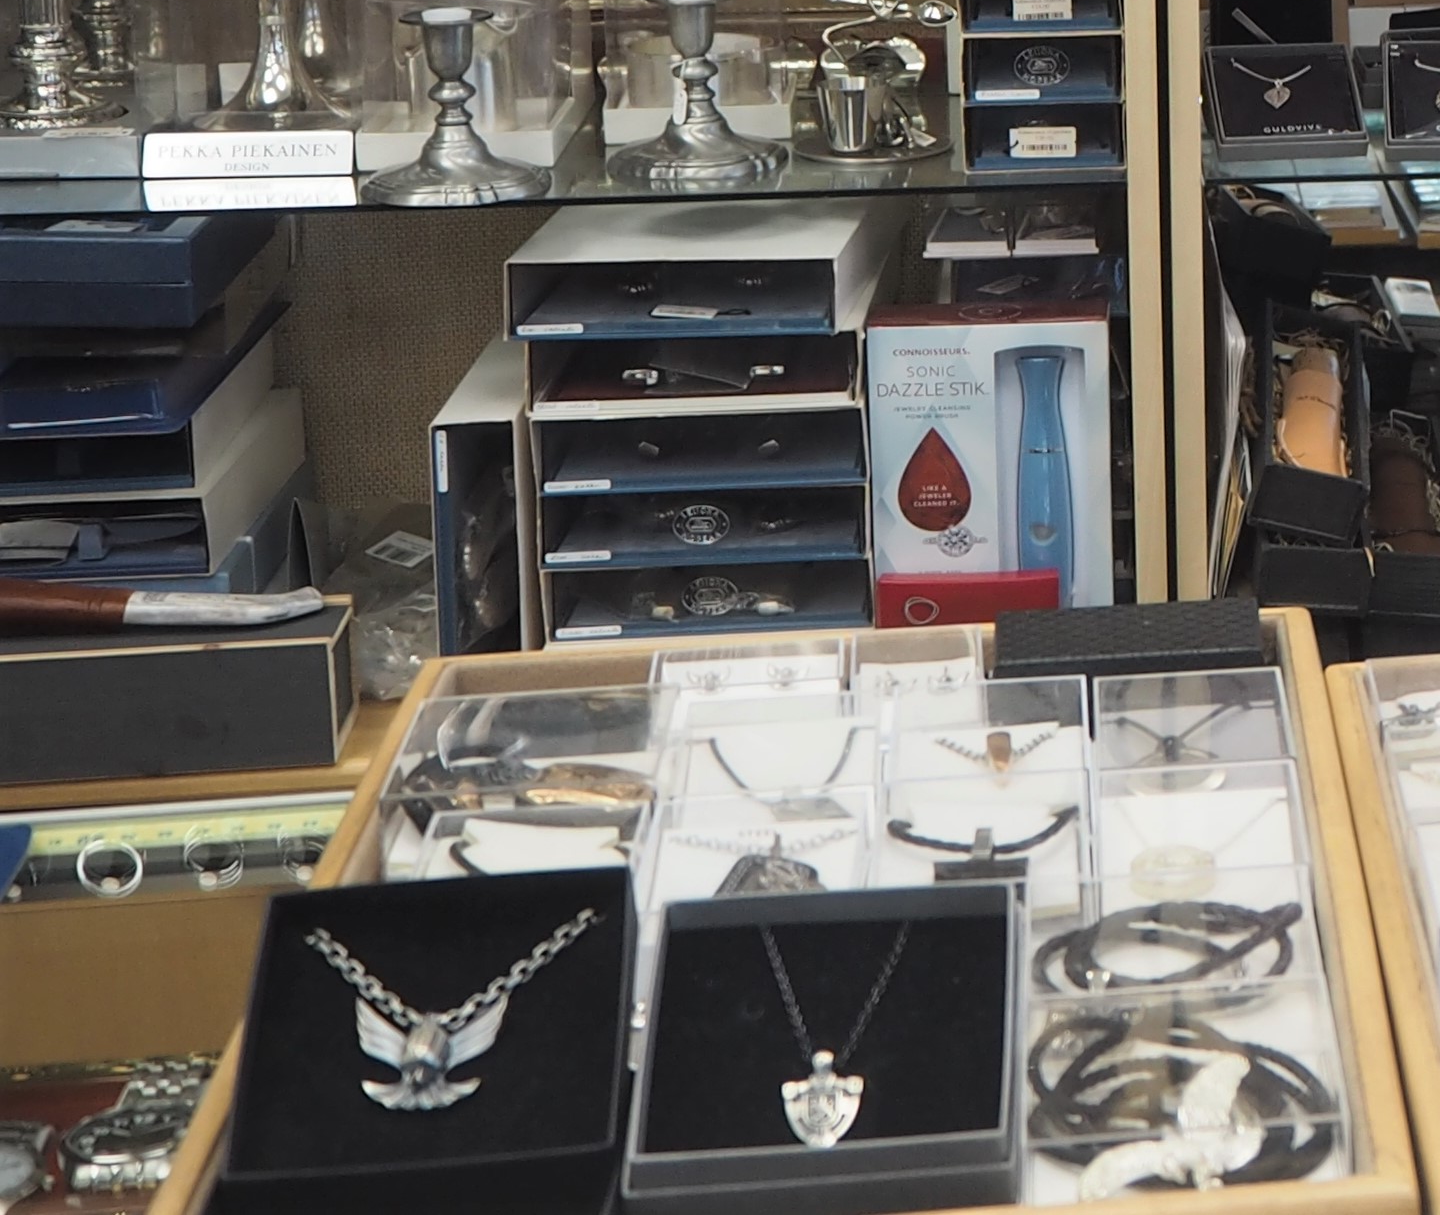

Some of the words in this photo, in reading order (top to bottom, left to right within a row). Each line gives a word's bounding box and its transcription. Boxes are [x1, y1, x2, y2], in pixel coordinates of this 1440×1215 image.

[158, 145, 222, 158] PEKKA
[224, 162, 270, 172] DESIGN
[892, 348, 969, 356] CONNOISSEURS
[906, 365, 956, 377] SONIC
[876, 383, 945, 398] DAZZLE
[949, 382, 985, 396] STIK
